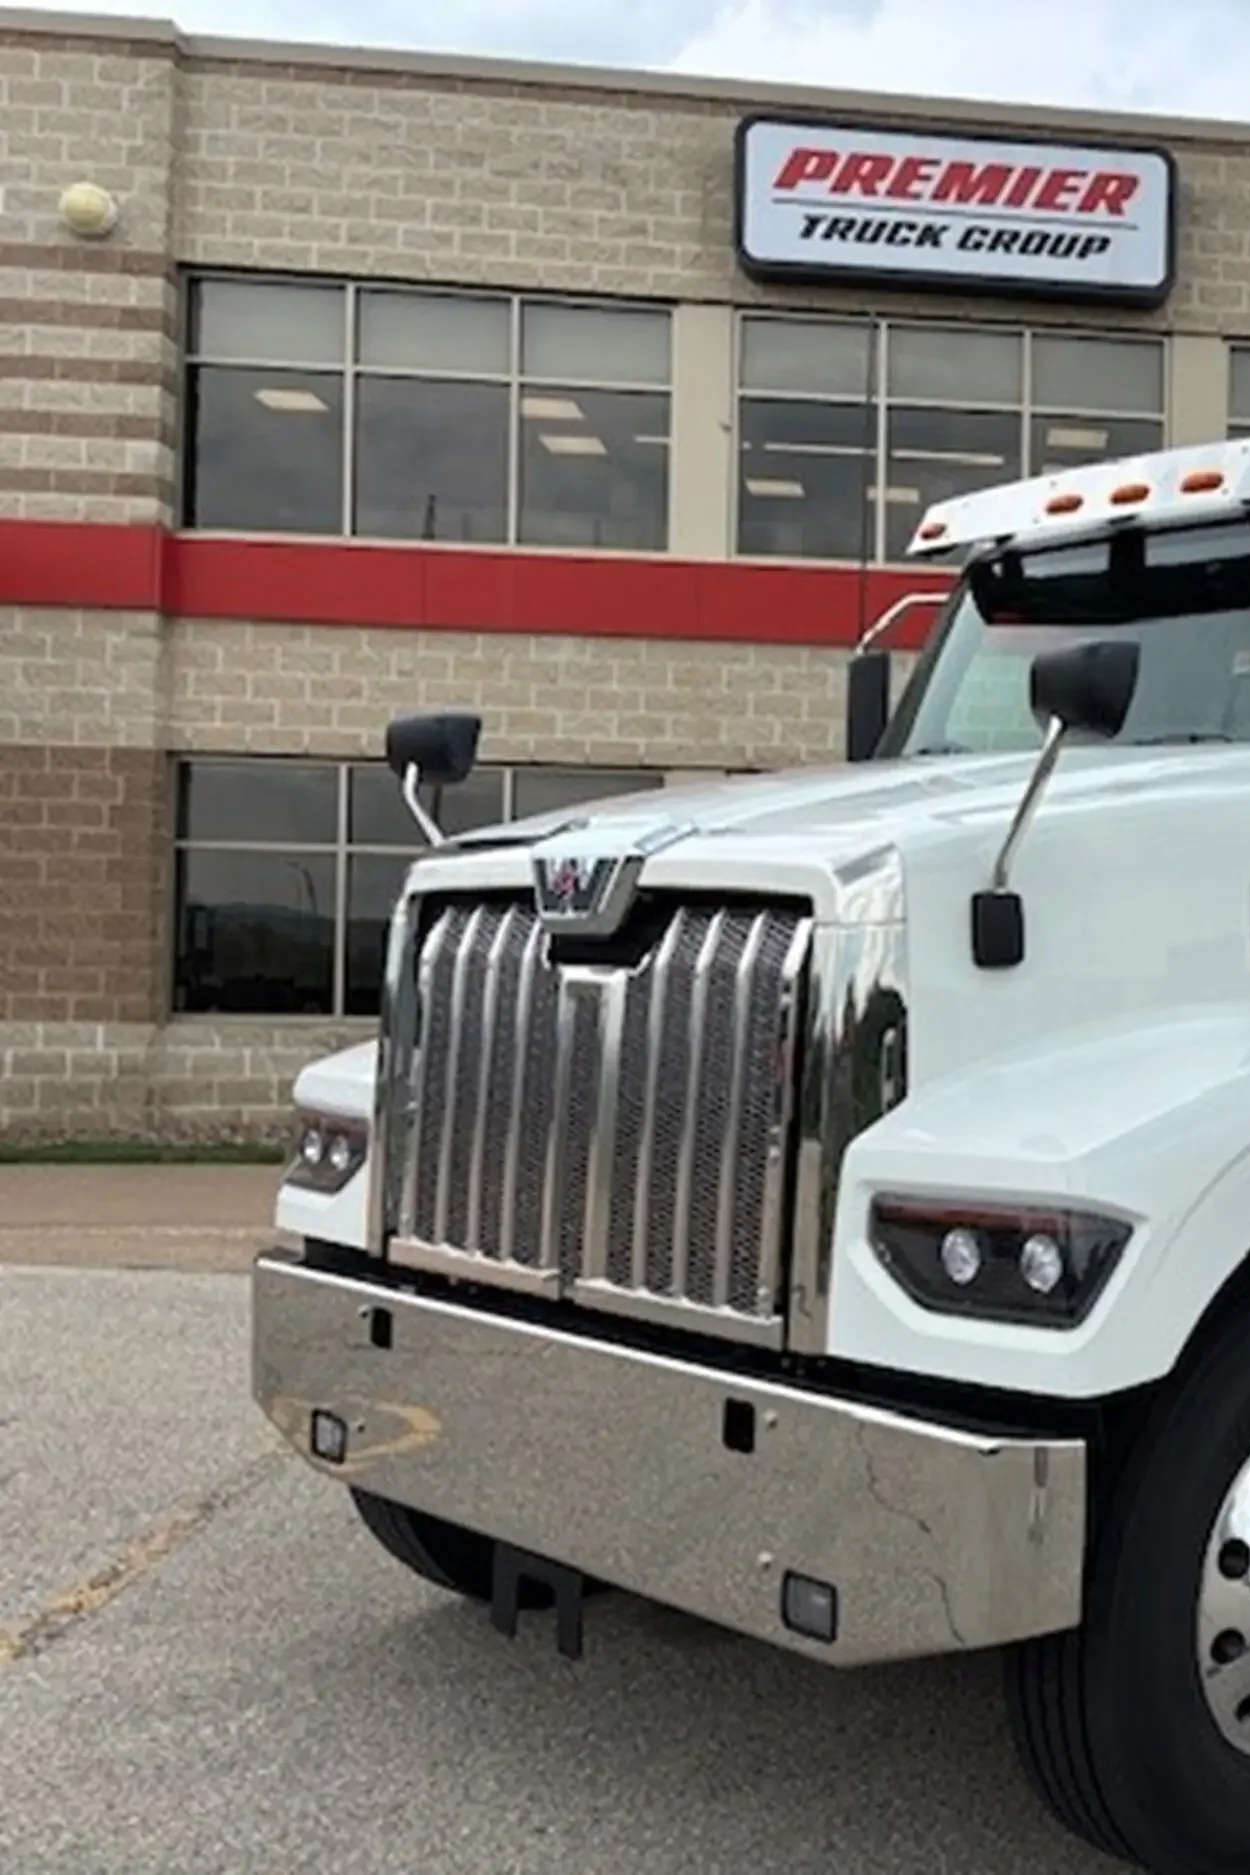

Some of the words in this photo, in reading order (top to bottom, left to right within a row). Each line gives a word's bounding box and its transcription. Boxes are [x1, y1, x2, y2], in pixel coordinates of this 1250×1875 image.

[774, 147, 1139, 215] PREMIER
[800, 214, 949, 247] TRUCK
[957, 226, 1111, 260] GROUP
